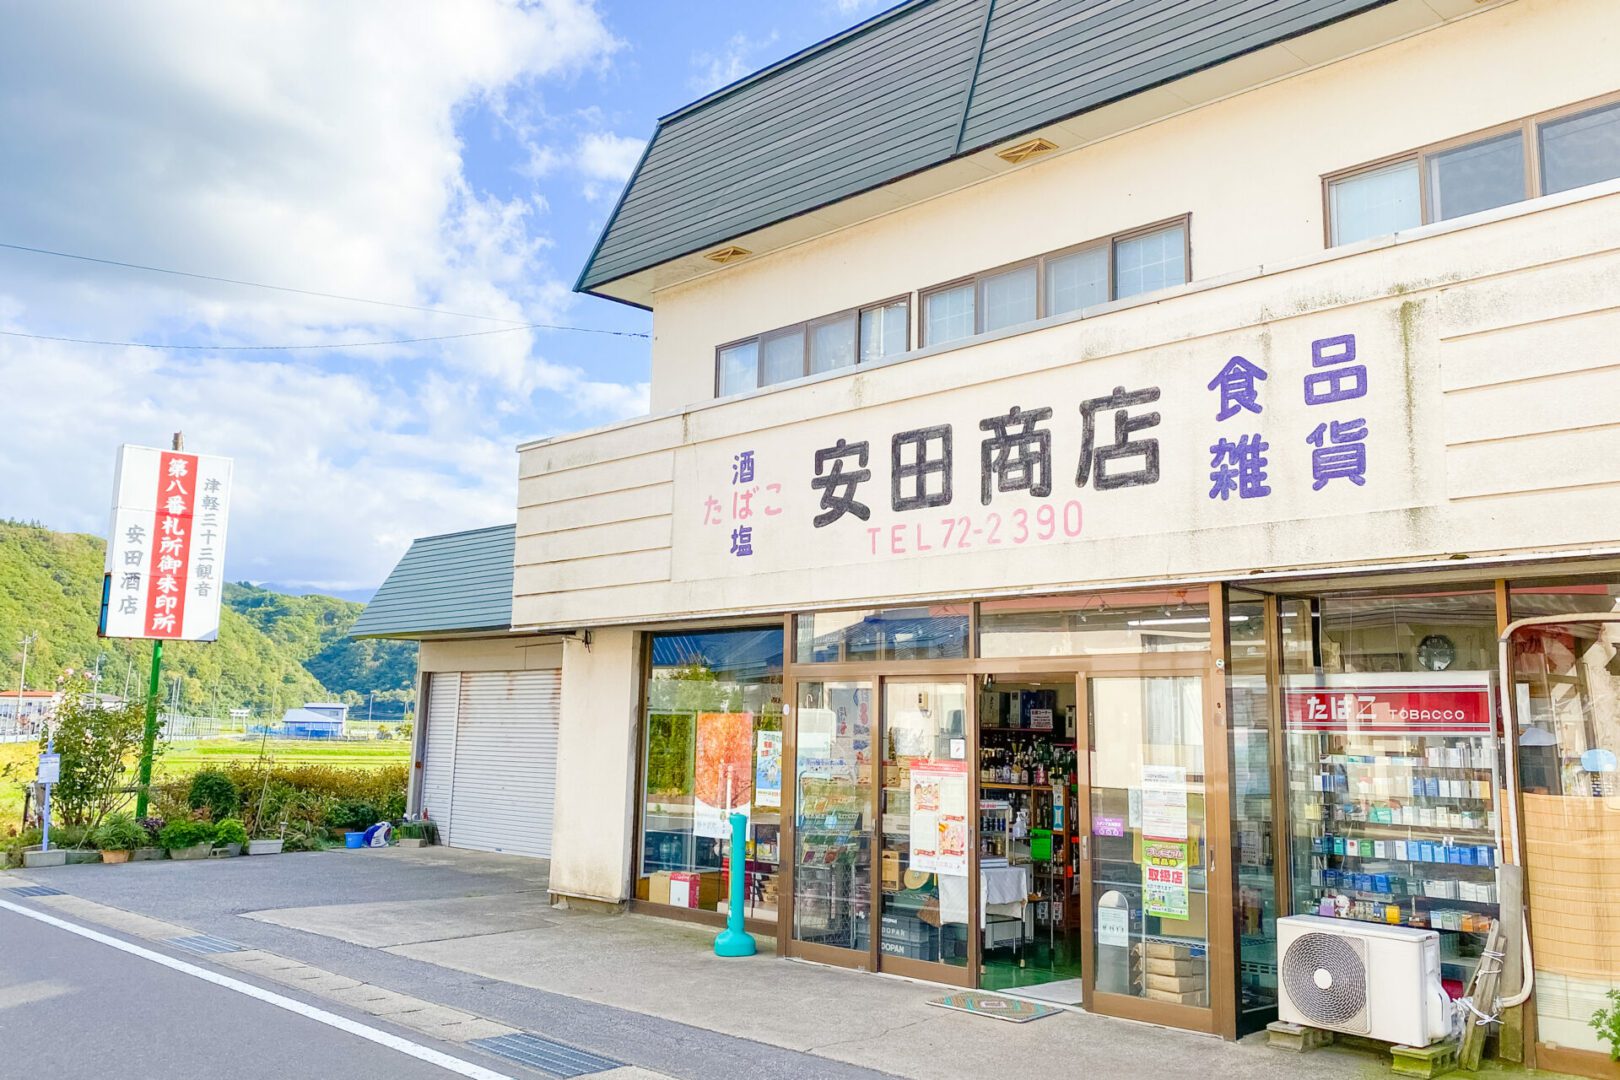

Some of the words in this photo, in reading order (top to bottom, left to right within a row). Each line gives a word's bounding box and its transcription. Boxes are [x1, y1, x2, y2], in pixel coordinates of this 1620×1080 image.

[1207, 333, 1368, 422] 食品
[732, 450, 755, 485] 酒
[811, 387, 1161, 530] 安田商店
[1208, 417, 1369, 502] 雑貨
[704, 483, 783, 525] たばこ
[867, 523, 930, 556] TEL
[942, 500, 1083, 550] 72-2390
[151, 457, 189, 634] 第八番札所御朱印所
[194, 477, 221, 598] 津軽三十三観音
[730, 525, 753, 557] 塩
[118, 524, 146, 616] 安田酒店
[1389, 708, 1465, 721] TOBACCO
[1148, 868, 1183, 884] 取扱店
[880, 927, 905, 937] DOPAN
[880, 942, 905, 954] DOPAN
